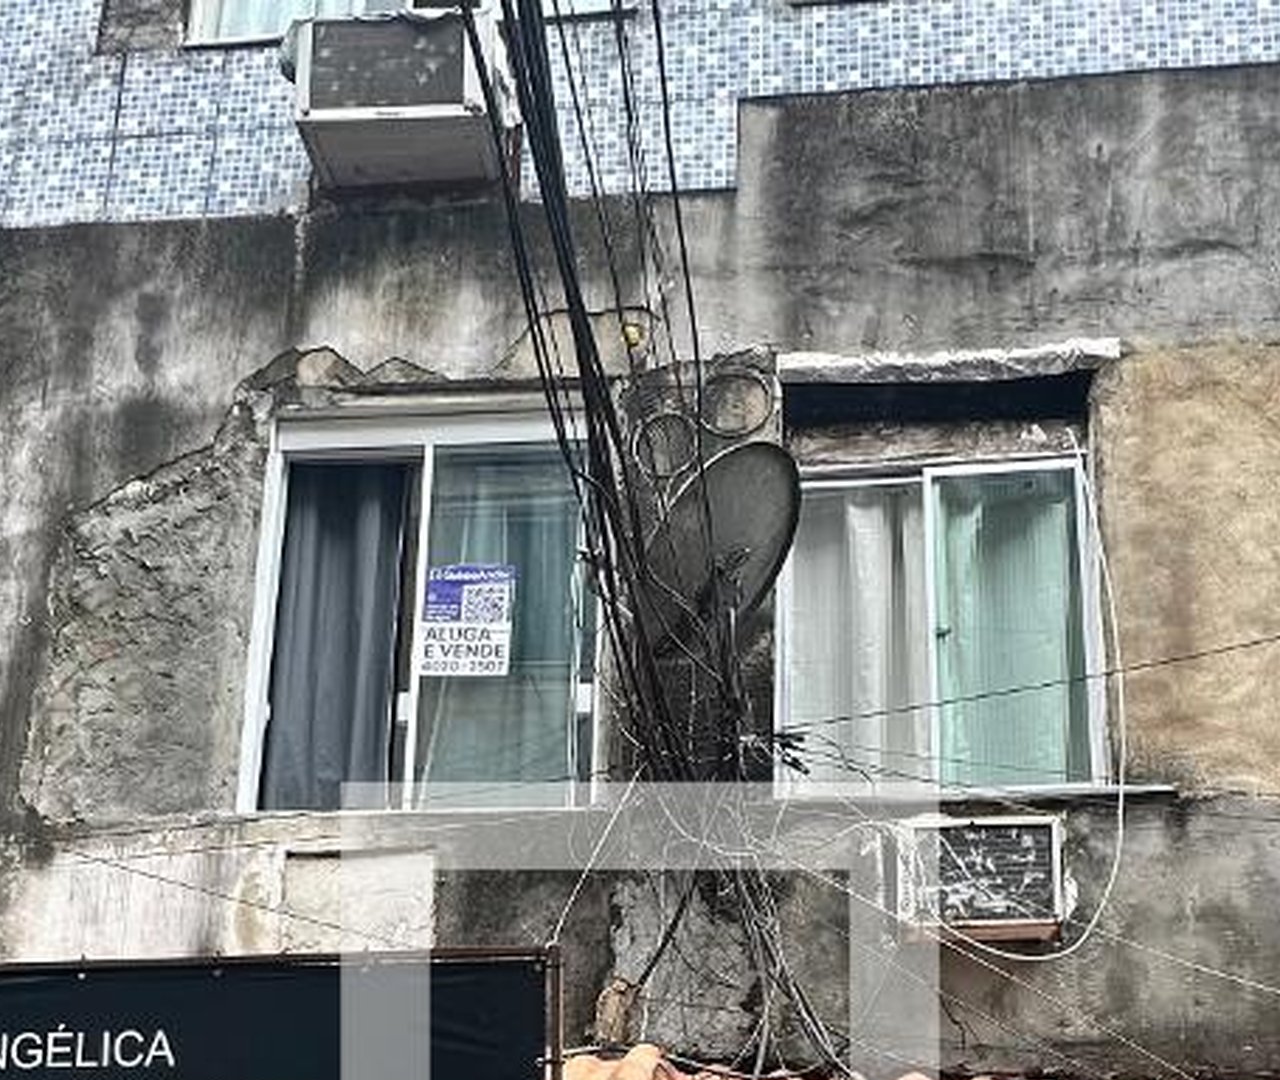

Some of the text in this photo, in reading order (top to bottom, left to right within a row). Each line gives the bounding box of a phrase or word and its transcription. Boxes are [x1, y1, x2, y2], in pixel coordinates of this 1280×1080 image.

[424, 627, 491, 642] ALUGA
[424, 643, 505, 659] E VENDE
